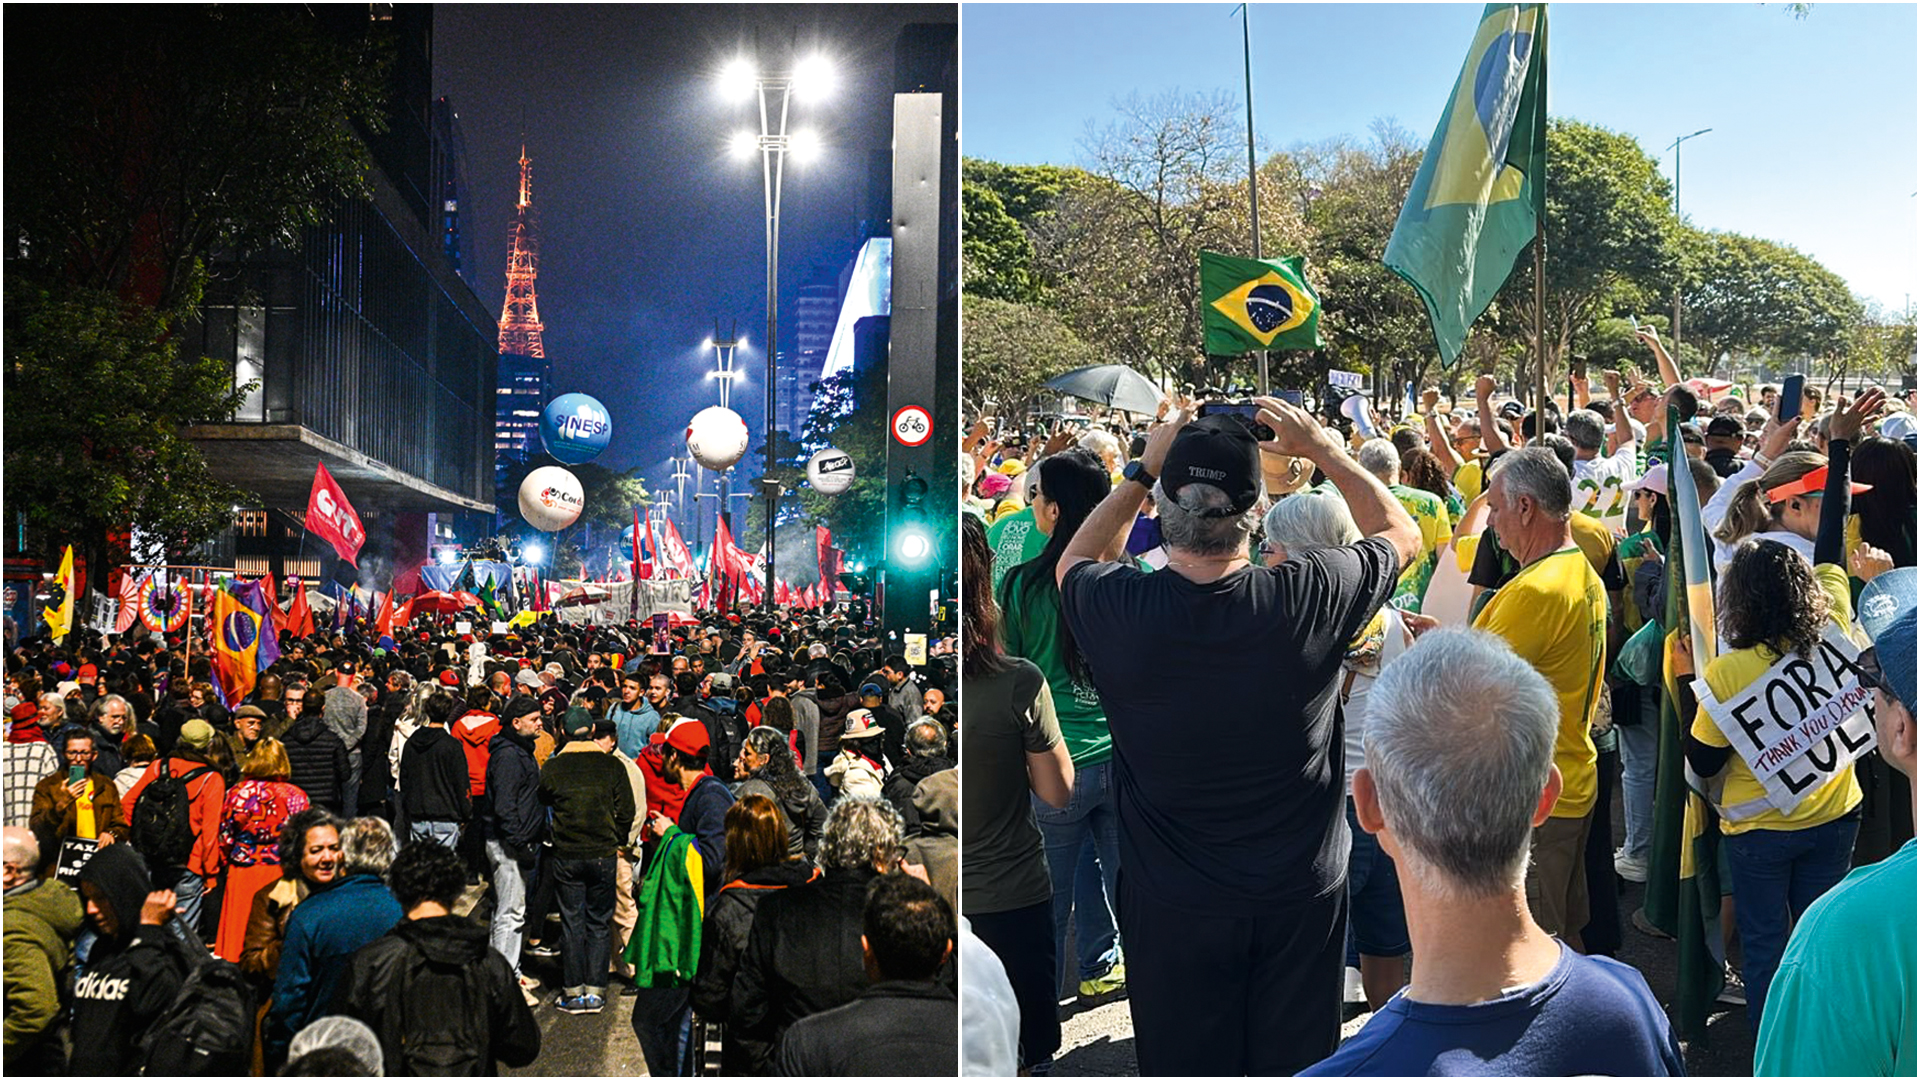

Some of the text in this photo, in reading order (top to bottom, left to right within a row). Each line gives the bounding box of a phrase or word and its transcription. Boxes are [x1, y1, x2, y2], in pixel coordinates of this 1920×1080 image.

[555, 414, 609, 435] SINESP
[1188, 465, 1227, 481] TRUMP
[1577, 475, 1624, 518] 22
[1731, 639, 1860, 751] FORA
[1754, 733, 1803, 772] THANK
[1800, 718, 1829, 744] YOU
[74, 970, 130, 1001] didas
